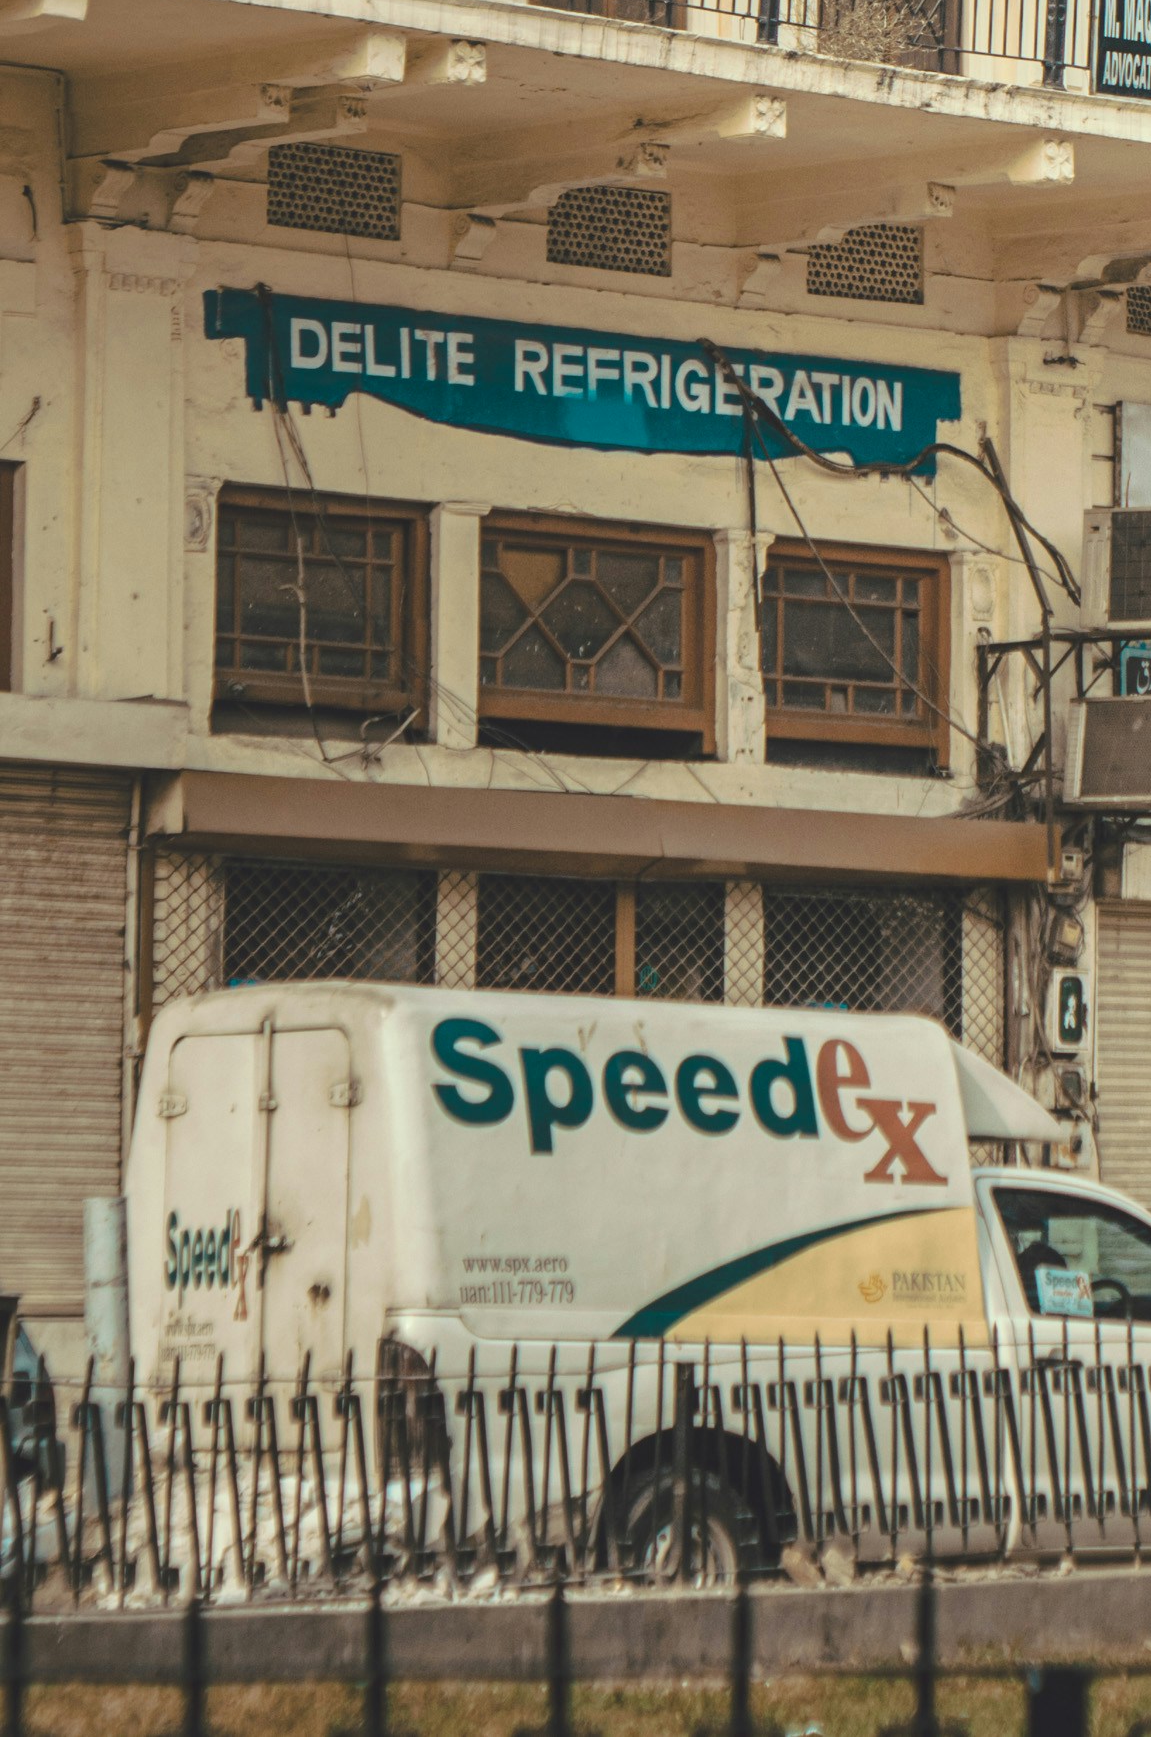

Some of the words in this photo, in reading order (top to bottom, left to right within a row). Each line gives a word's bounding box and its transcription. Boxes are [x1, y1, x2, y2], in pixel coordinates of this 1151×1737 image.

[290, 318, 475, 387] DELITE
[514, 339, 903, 432] REFRIGERATION
[461, 1255, 569, 1276] www.spx.aero
[459, 1280, 575, 1304] uan:111-779-779
[892, 1271, 967, 1292] PAKISTAN
